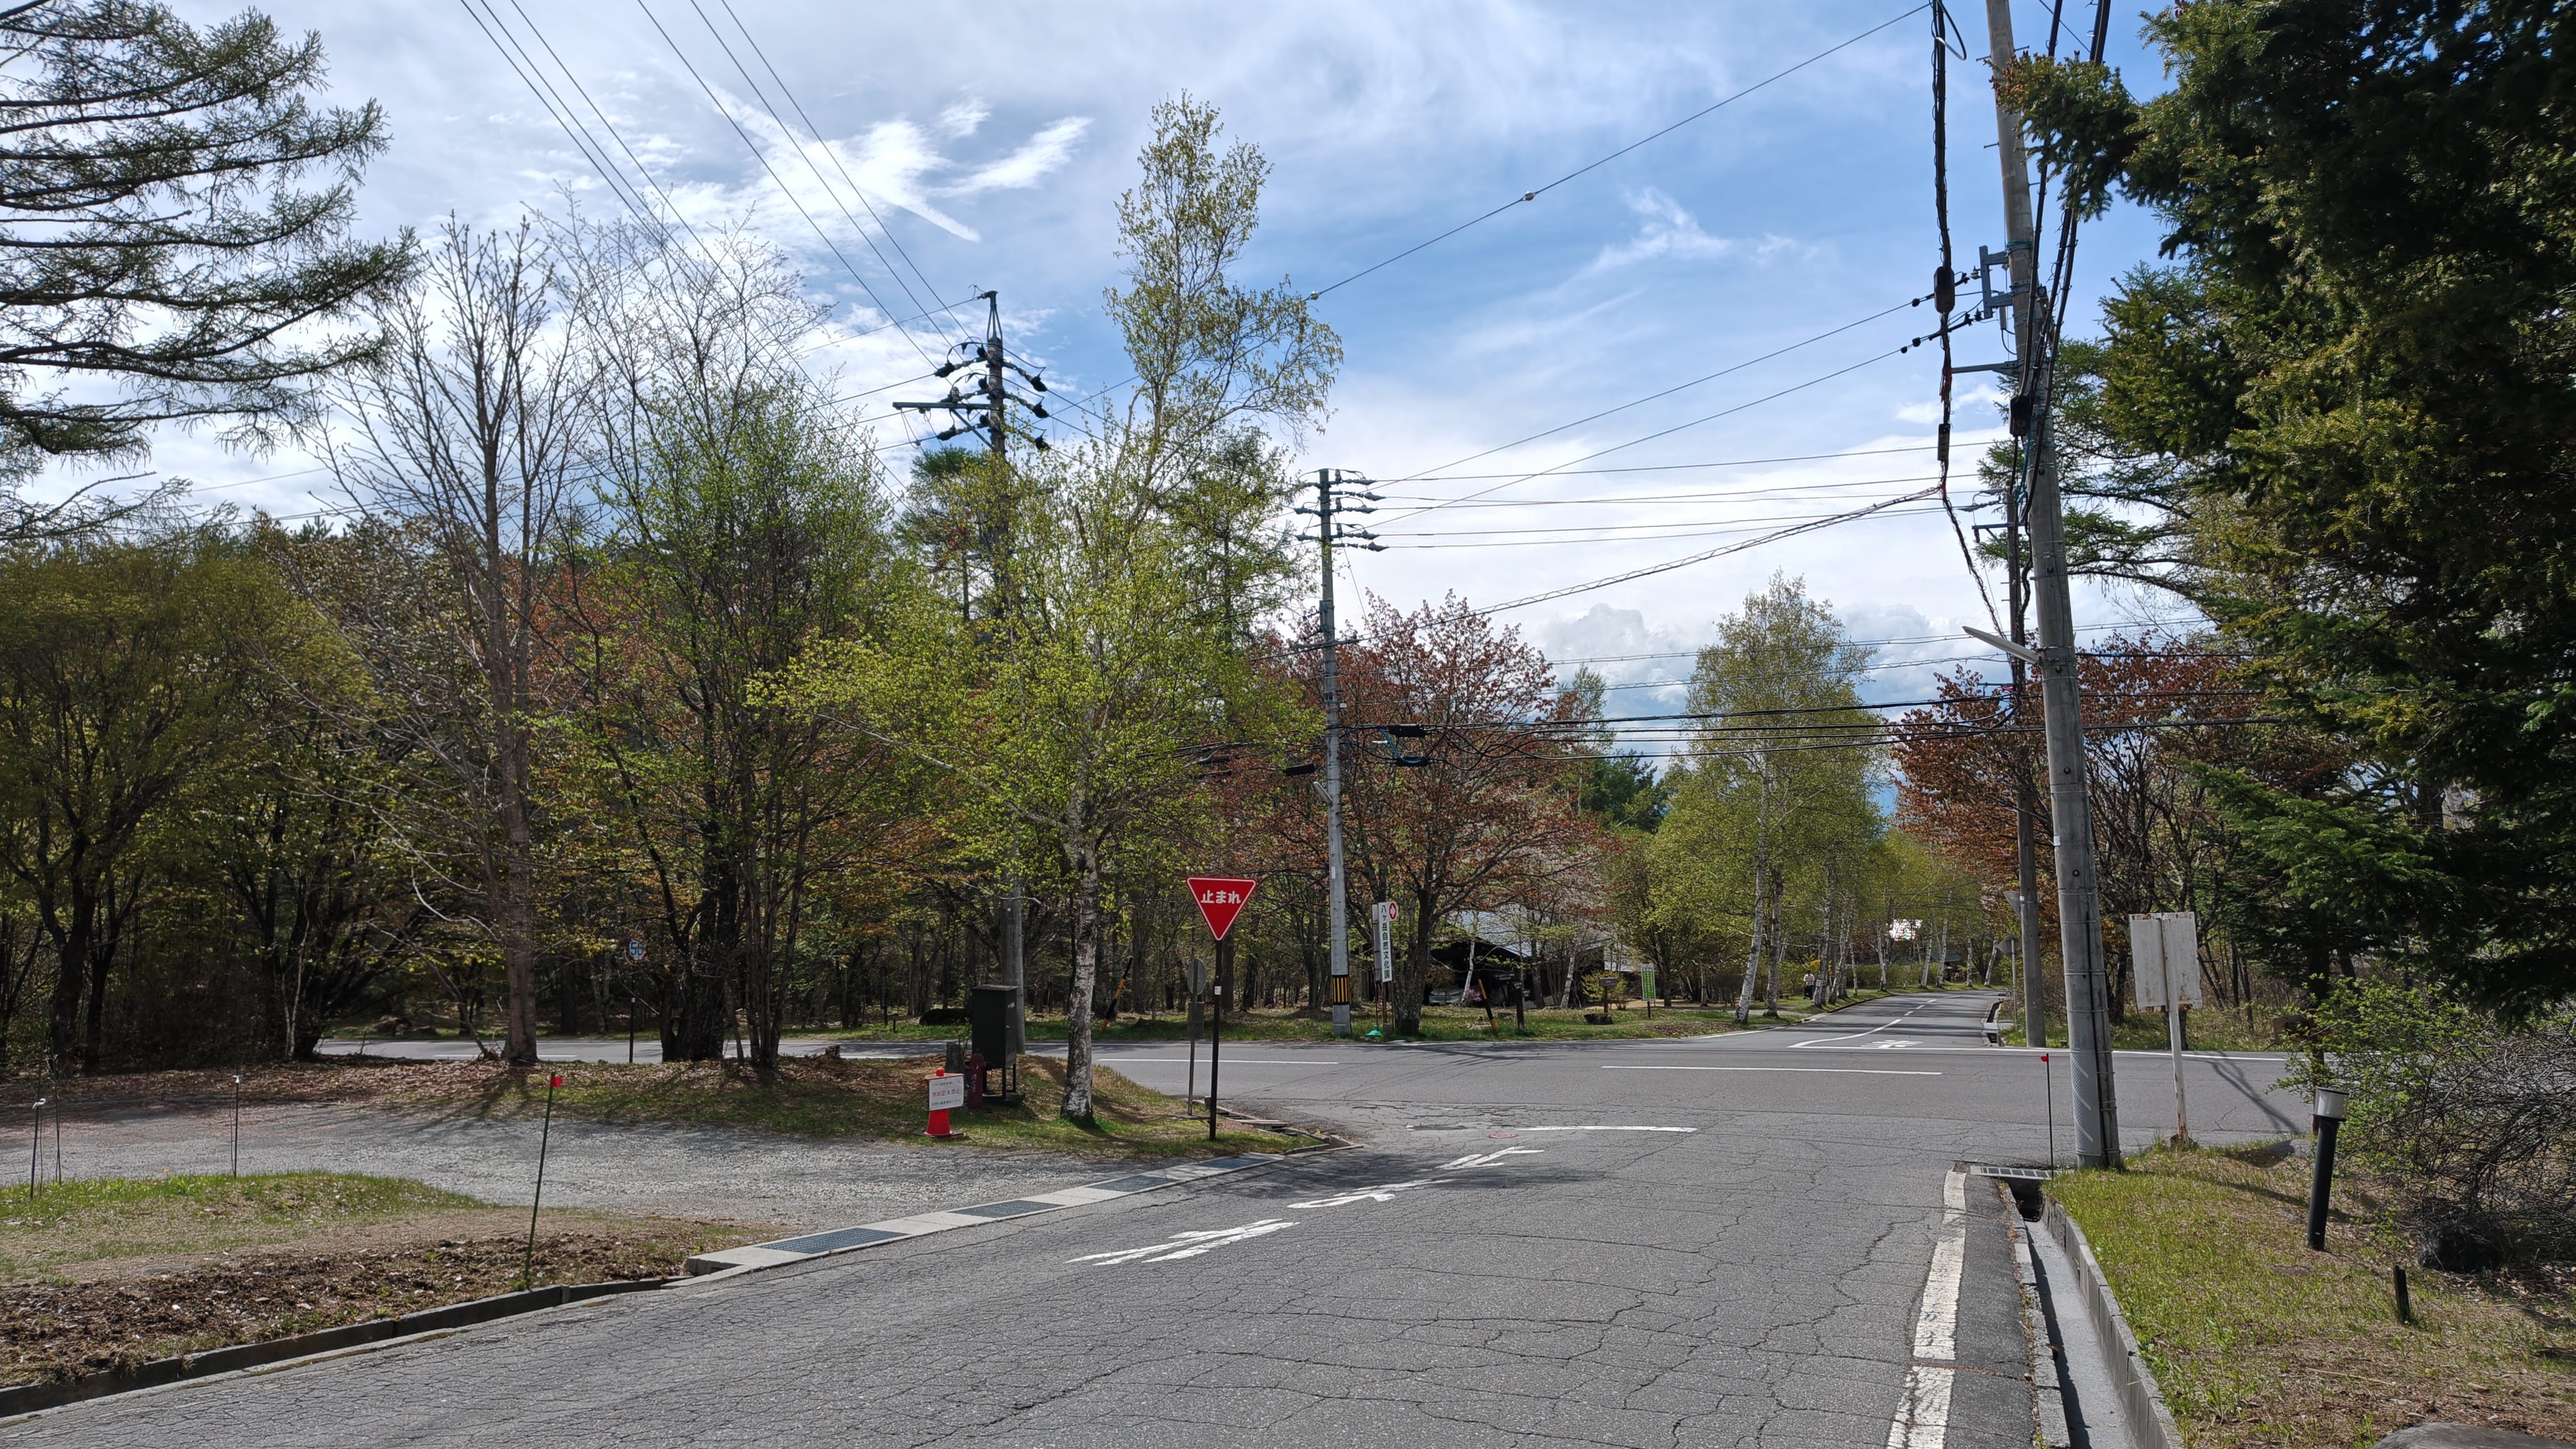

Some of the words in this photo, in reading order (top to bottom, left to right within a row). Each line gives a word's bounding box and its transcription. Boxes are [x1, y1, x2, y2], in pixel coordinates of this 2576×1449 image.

[1200, 889, 1241, 904] 止まれ
[631, 941, 644, 956] 50
